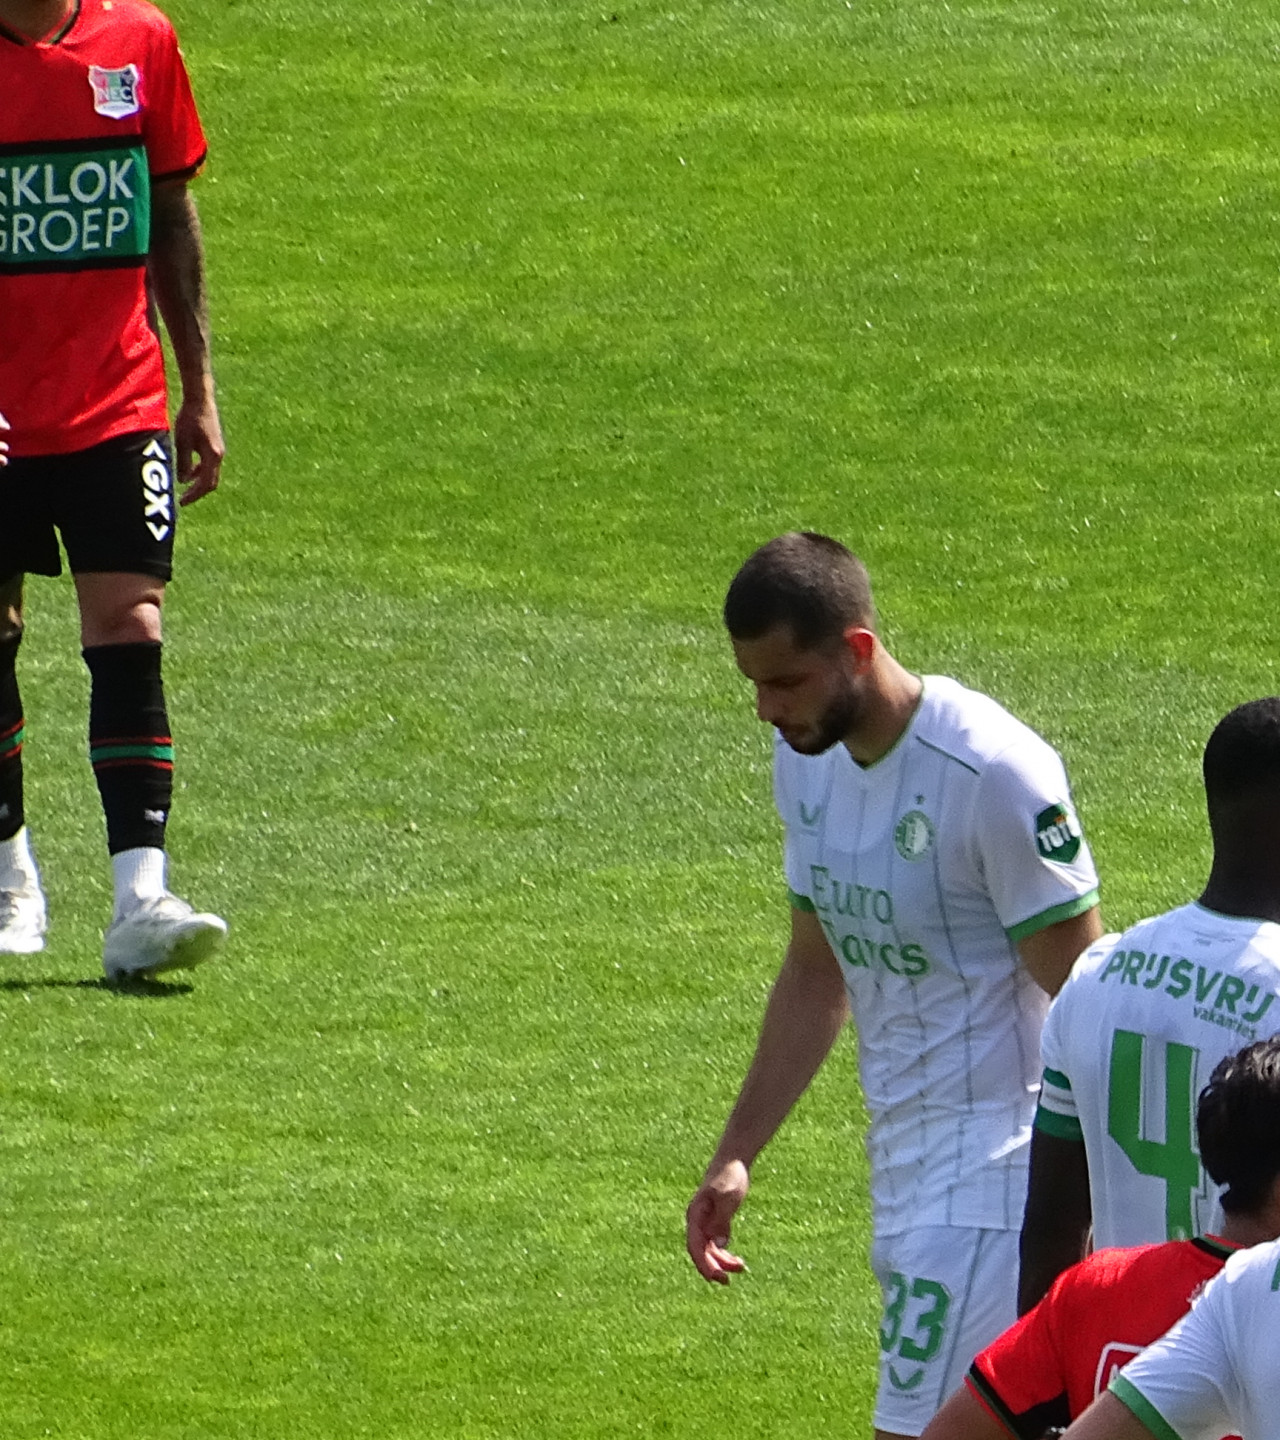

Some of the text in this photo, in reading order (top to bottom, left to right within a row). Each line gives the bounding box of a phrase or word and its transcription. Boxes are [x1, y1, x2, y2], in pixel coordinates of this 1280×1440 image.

[810, 864, 893, 925] Euro
[1099, 950, 1275, 1024] PRIJSVRIJ
[1108, 1028, 1203, 1242] 4
[879, 1270, 951, 1363] 33
